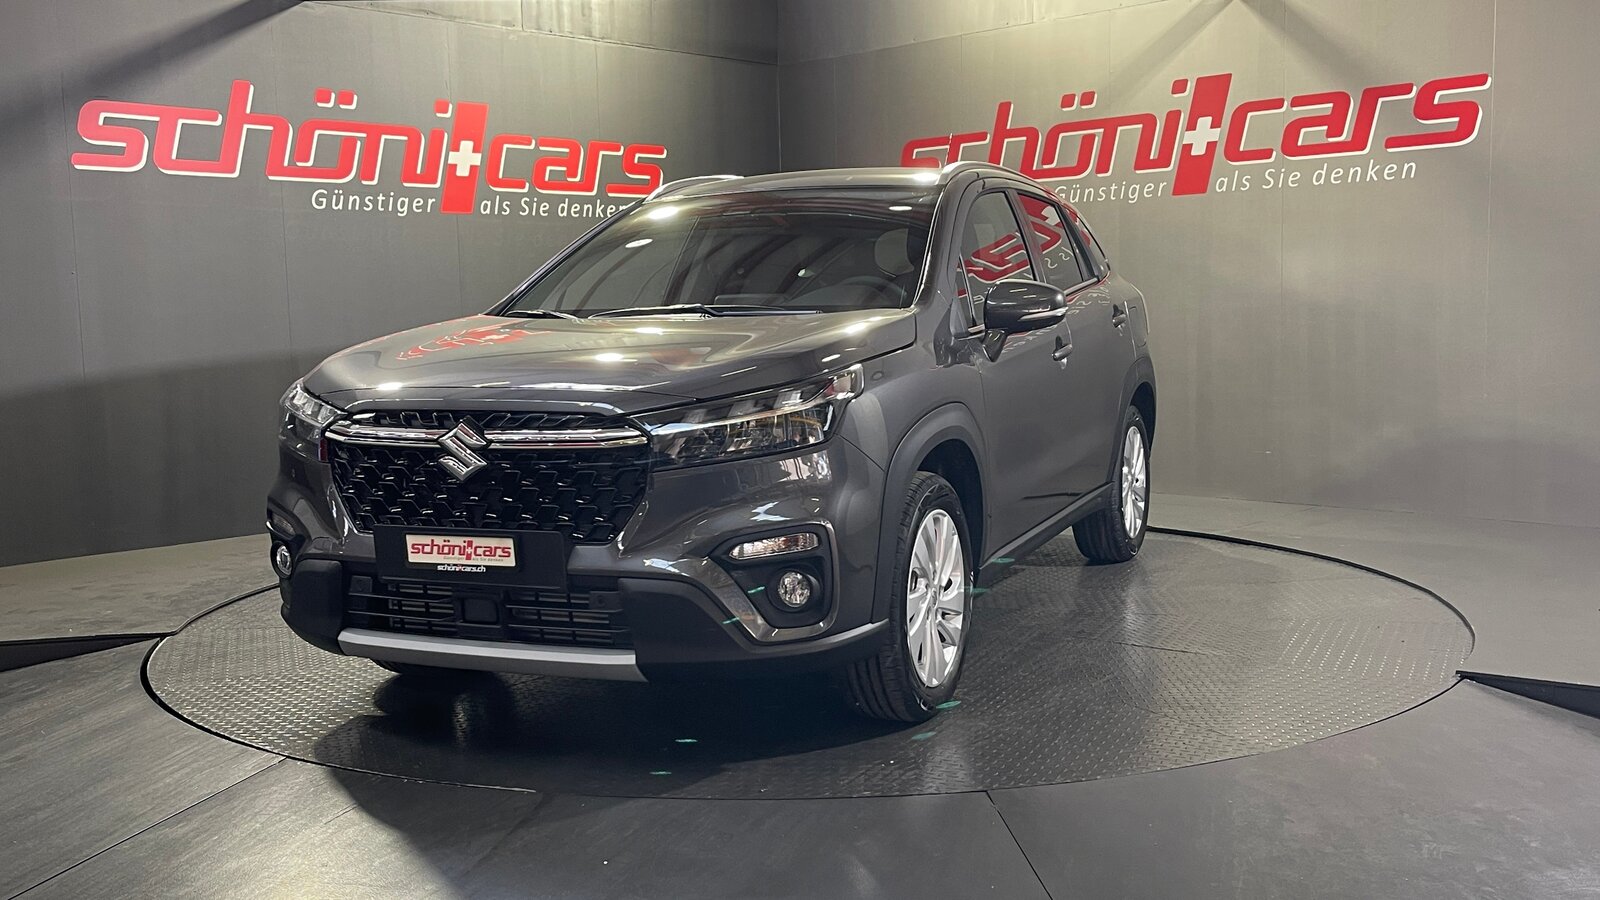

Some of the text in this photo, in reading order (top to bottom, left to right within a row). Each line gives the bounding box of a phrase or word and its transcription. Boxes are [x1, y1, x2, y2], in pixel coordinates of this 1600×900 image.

[1215, 170, 1251, 193] als
[1262, 168, 1301, 190] Sie
[1312, 158, 1417, 186] denken
[311, 188, 436, 217] Günstiger
[480, 195, 511, 215] als
[519, 197, 550, 216] Sie
